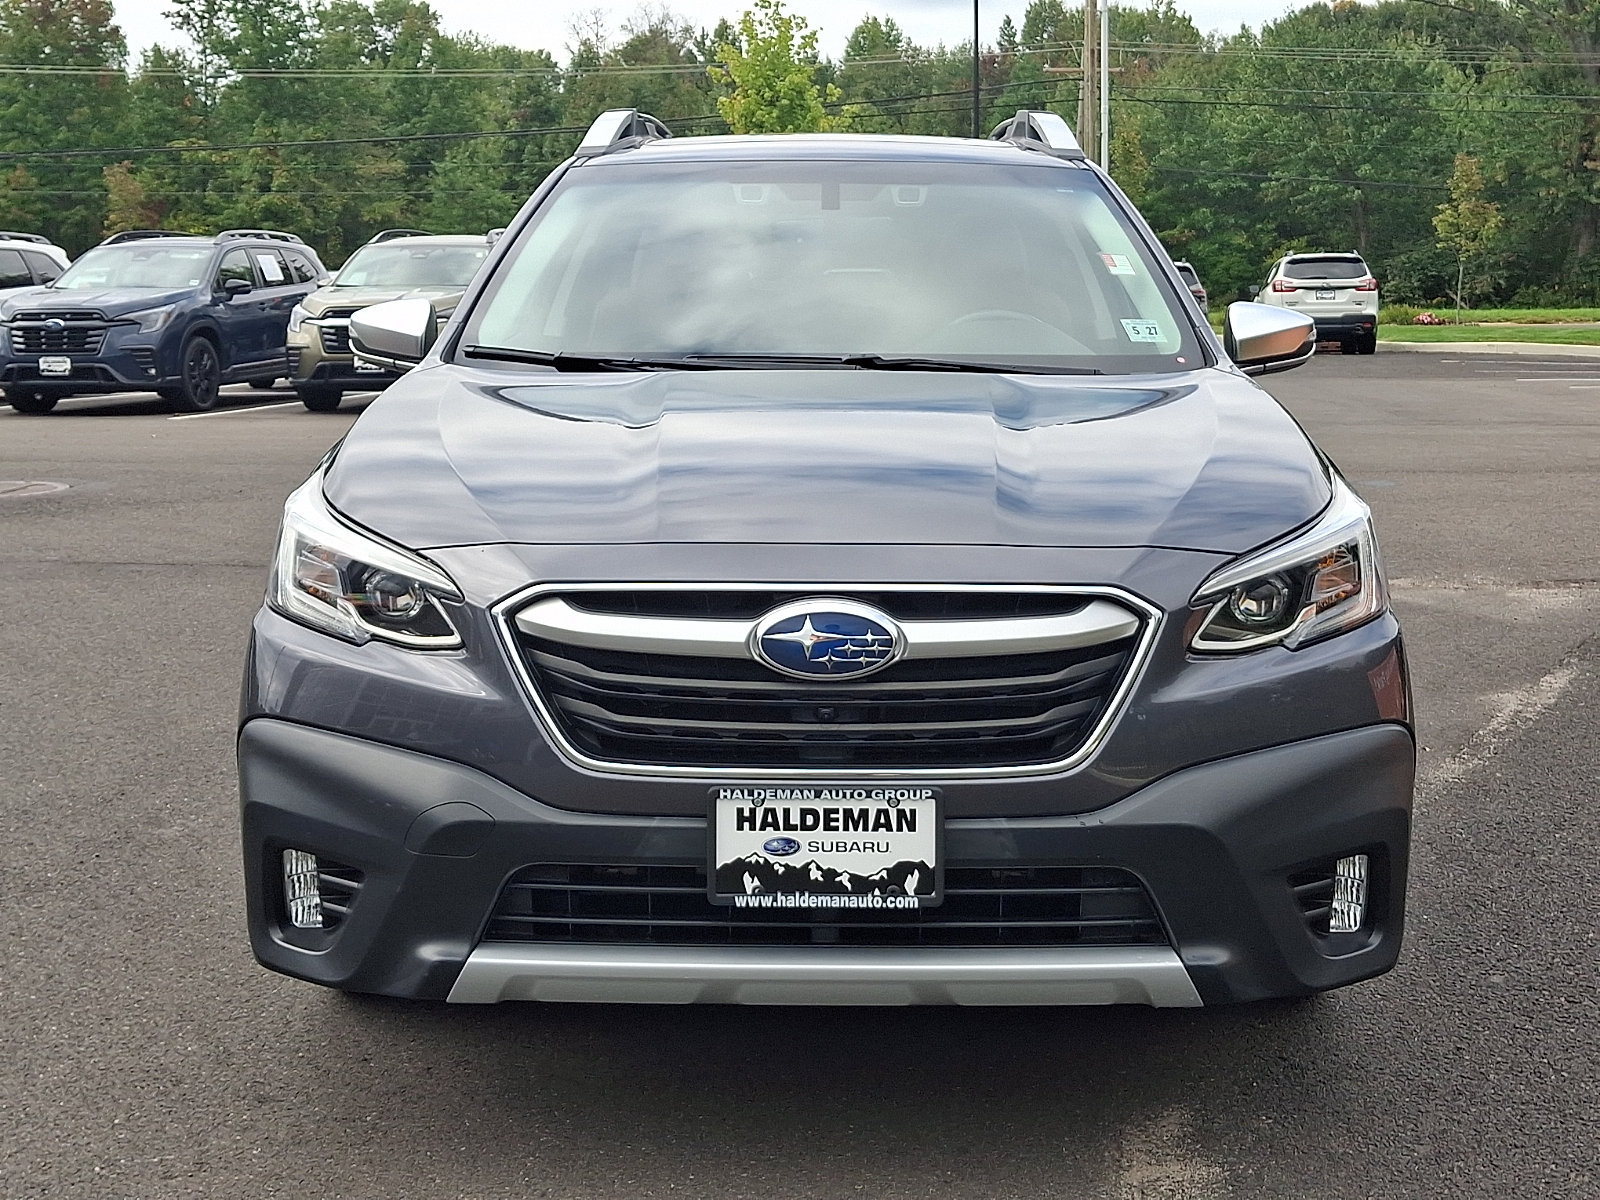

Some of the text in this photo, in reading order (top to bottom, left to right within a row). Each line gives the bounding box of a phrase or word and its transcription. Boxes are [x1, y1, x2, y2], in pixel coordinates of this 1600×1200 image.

[1131, 326, 1158, 336] 5 27
[719, 788, 933, 800] HALDEMAN AUTO GROUP
[735, 807, 917, 832] HALDEMAN
[807, 841, 890, 853] SUBARU
[734, 891, 919, 909] www.haldemanauto.com
